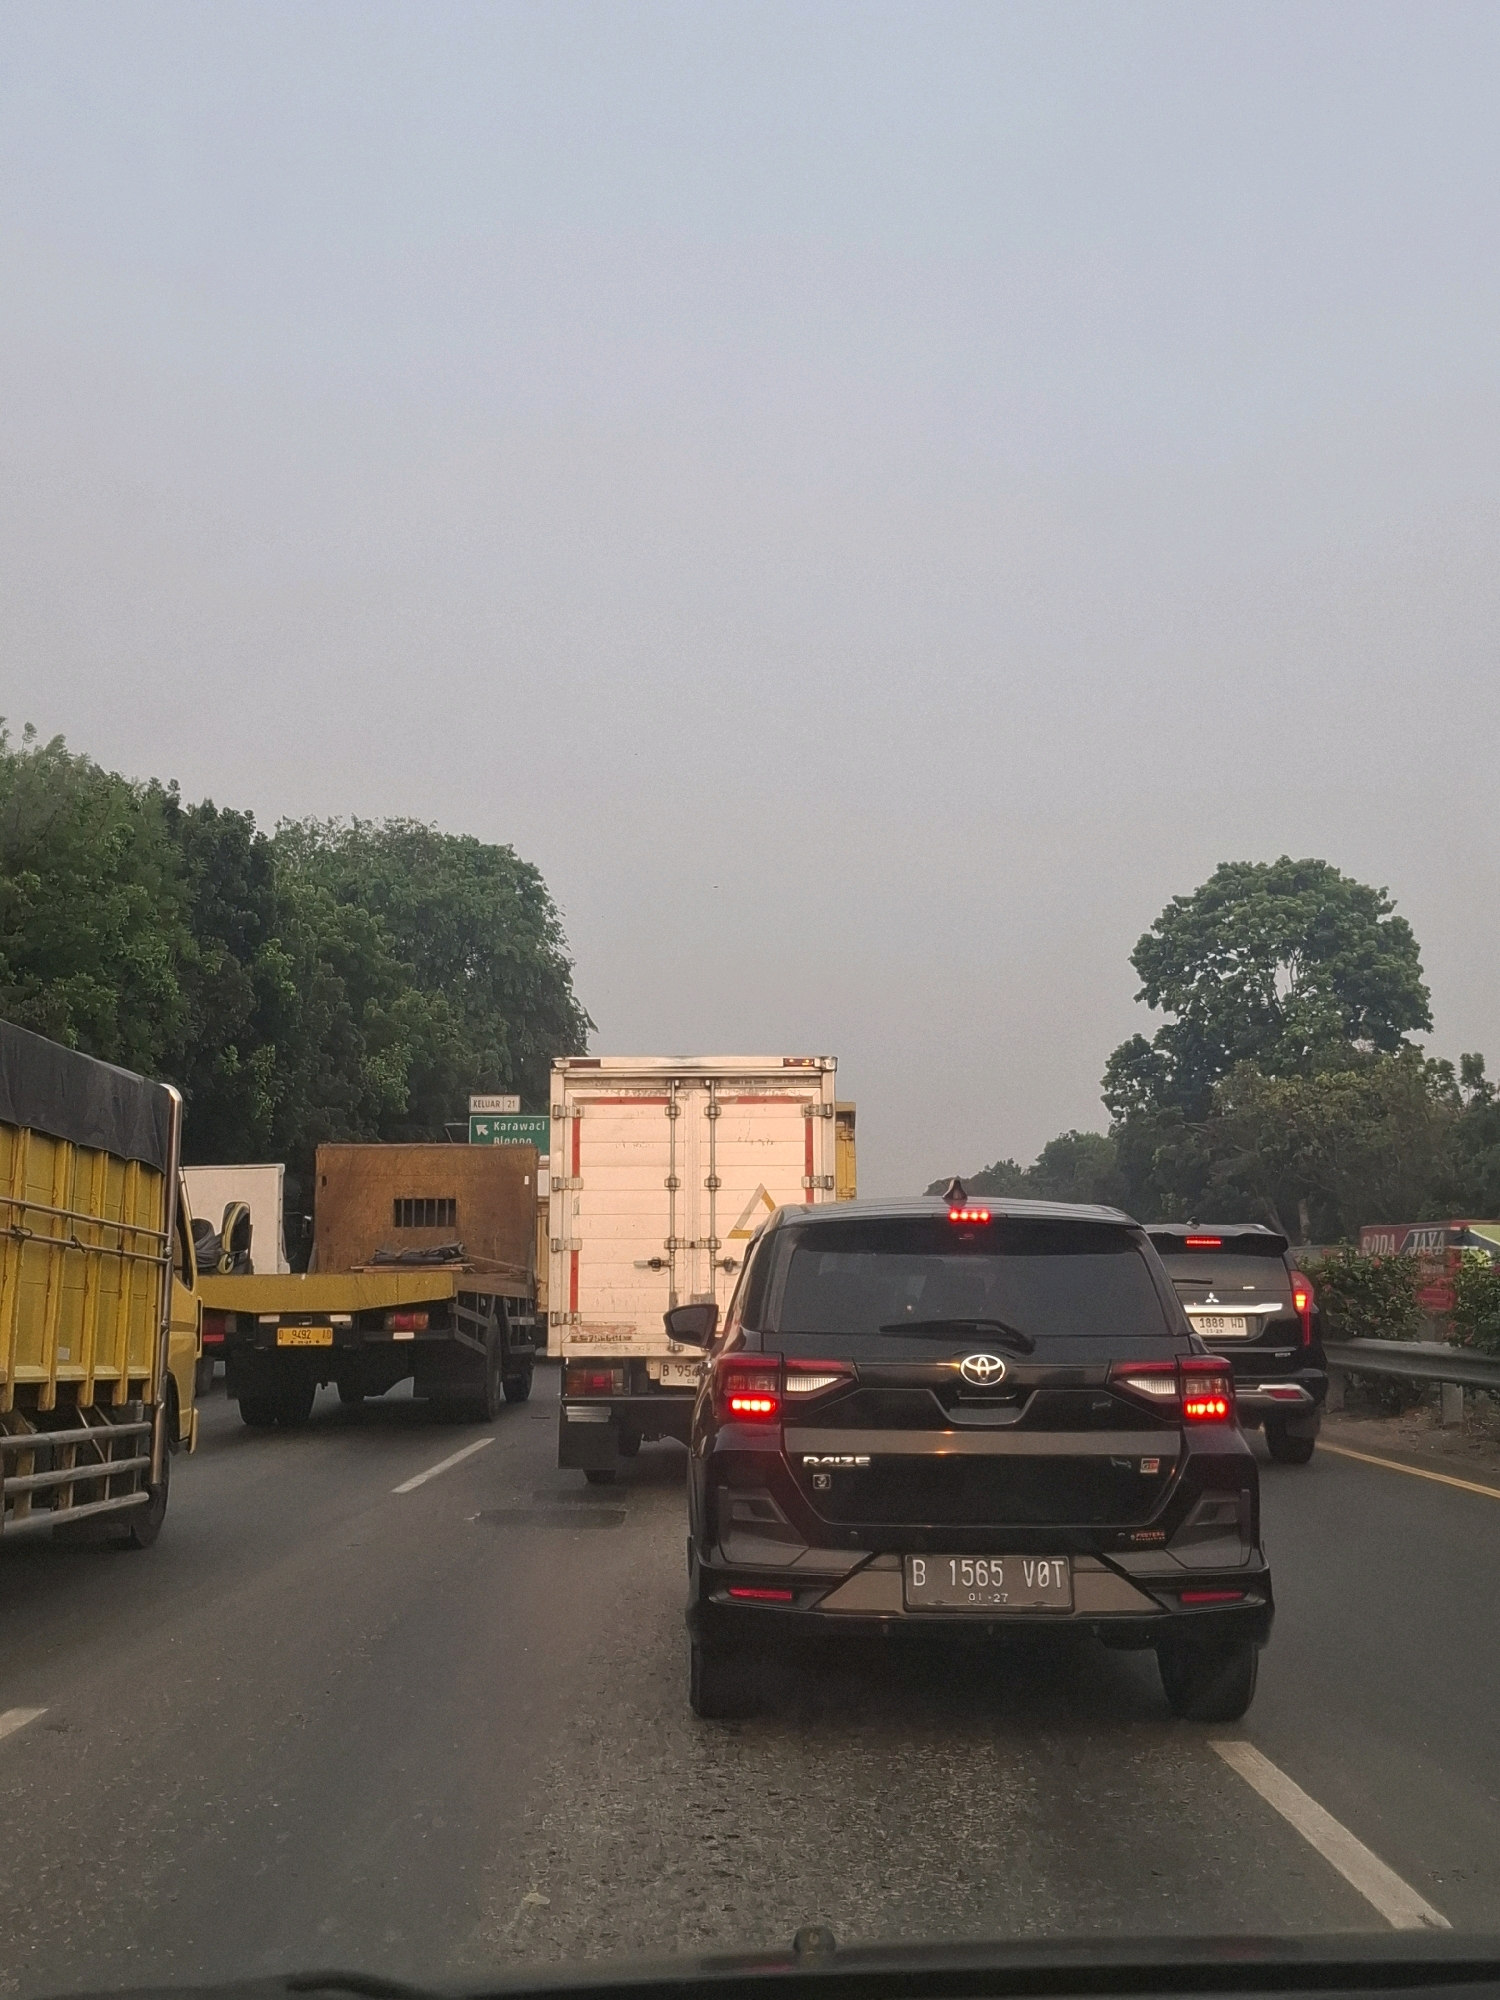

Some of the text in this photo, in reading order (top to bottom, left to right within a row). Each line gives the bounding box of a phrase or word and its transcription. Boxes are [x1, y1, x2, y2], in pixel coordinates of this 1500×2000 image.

[473, 1100, 515, 1109] KELUAR 21
[493, 1121, 545, 1131] Karawaci
[1199, 1317, 1225, 1329] 1888
[291, 1329, 312, 1340] 9492
[662, 1365, 670, 1377] B
[802, 1456, 871, 1468] RAIZE
[912, 1559, 926, 1587] B
[949, 1559, 1004, 1588] 1565
